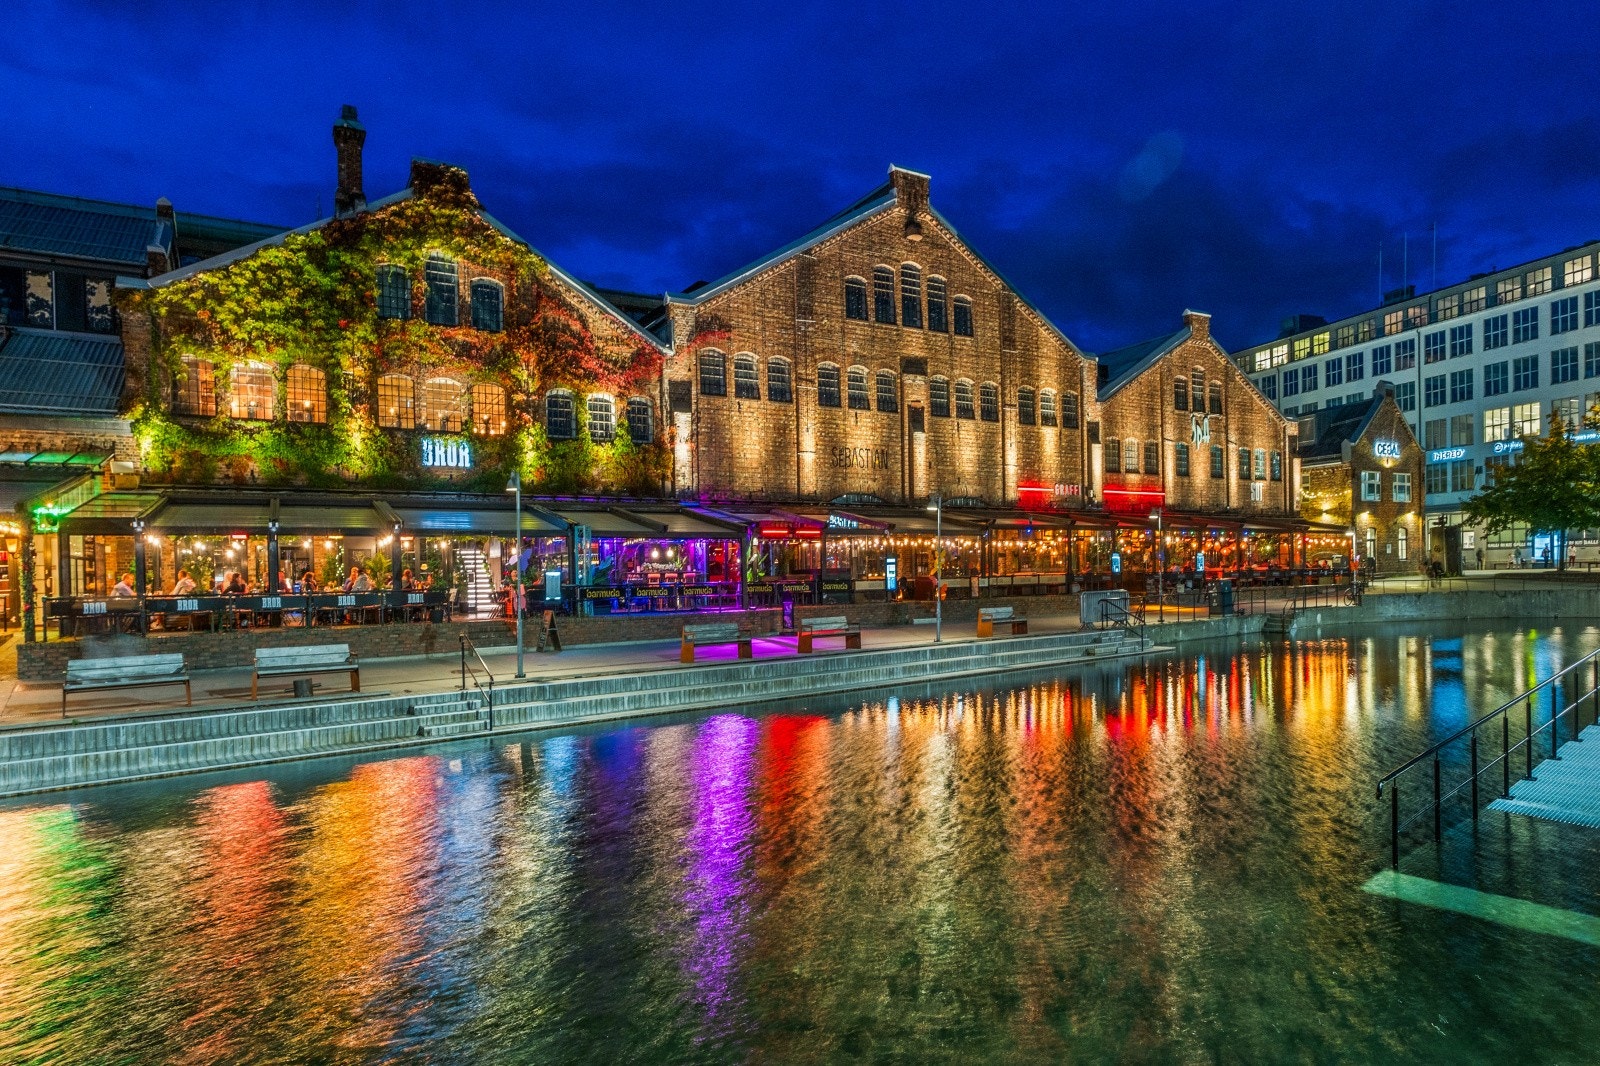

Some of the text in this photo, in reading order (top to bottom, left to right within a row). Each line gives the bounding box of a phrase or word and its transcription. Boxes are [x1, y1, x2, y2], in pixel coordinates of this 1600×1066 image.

[422, 438, 470, 467] BROR
[831, 446, 888, 470] SEBASTIAN
[176, 599, 199, 611] BROR
[261, 597, 281, 608] BROR
[337, 595, 355, 606] BROR
[82, 602, 107, 615] BROR
